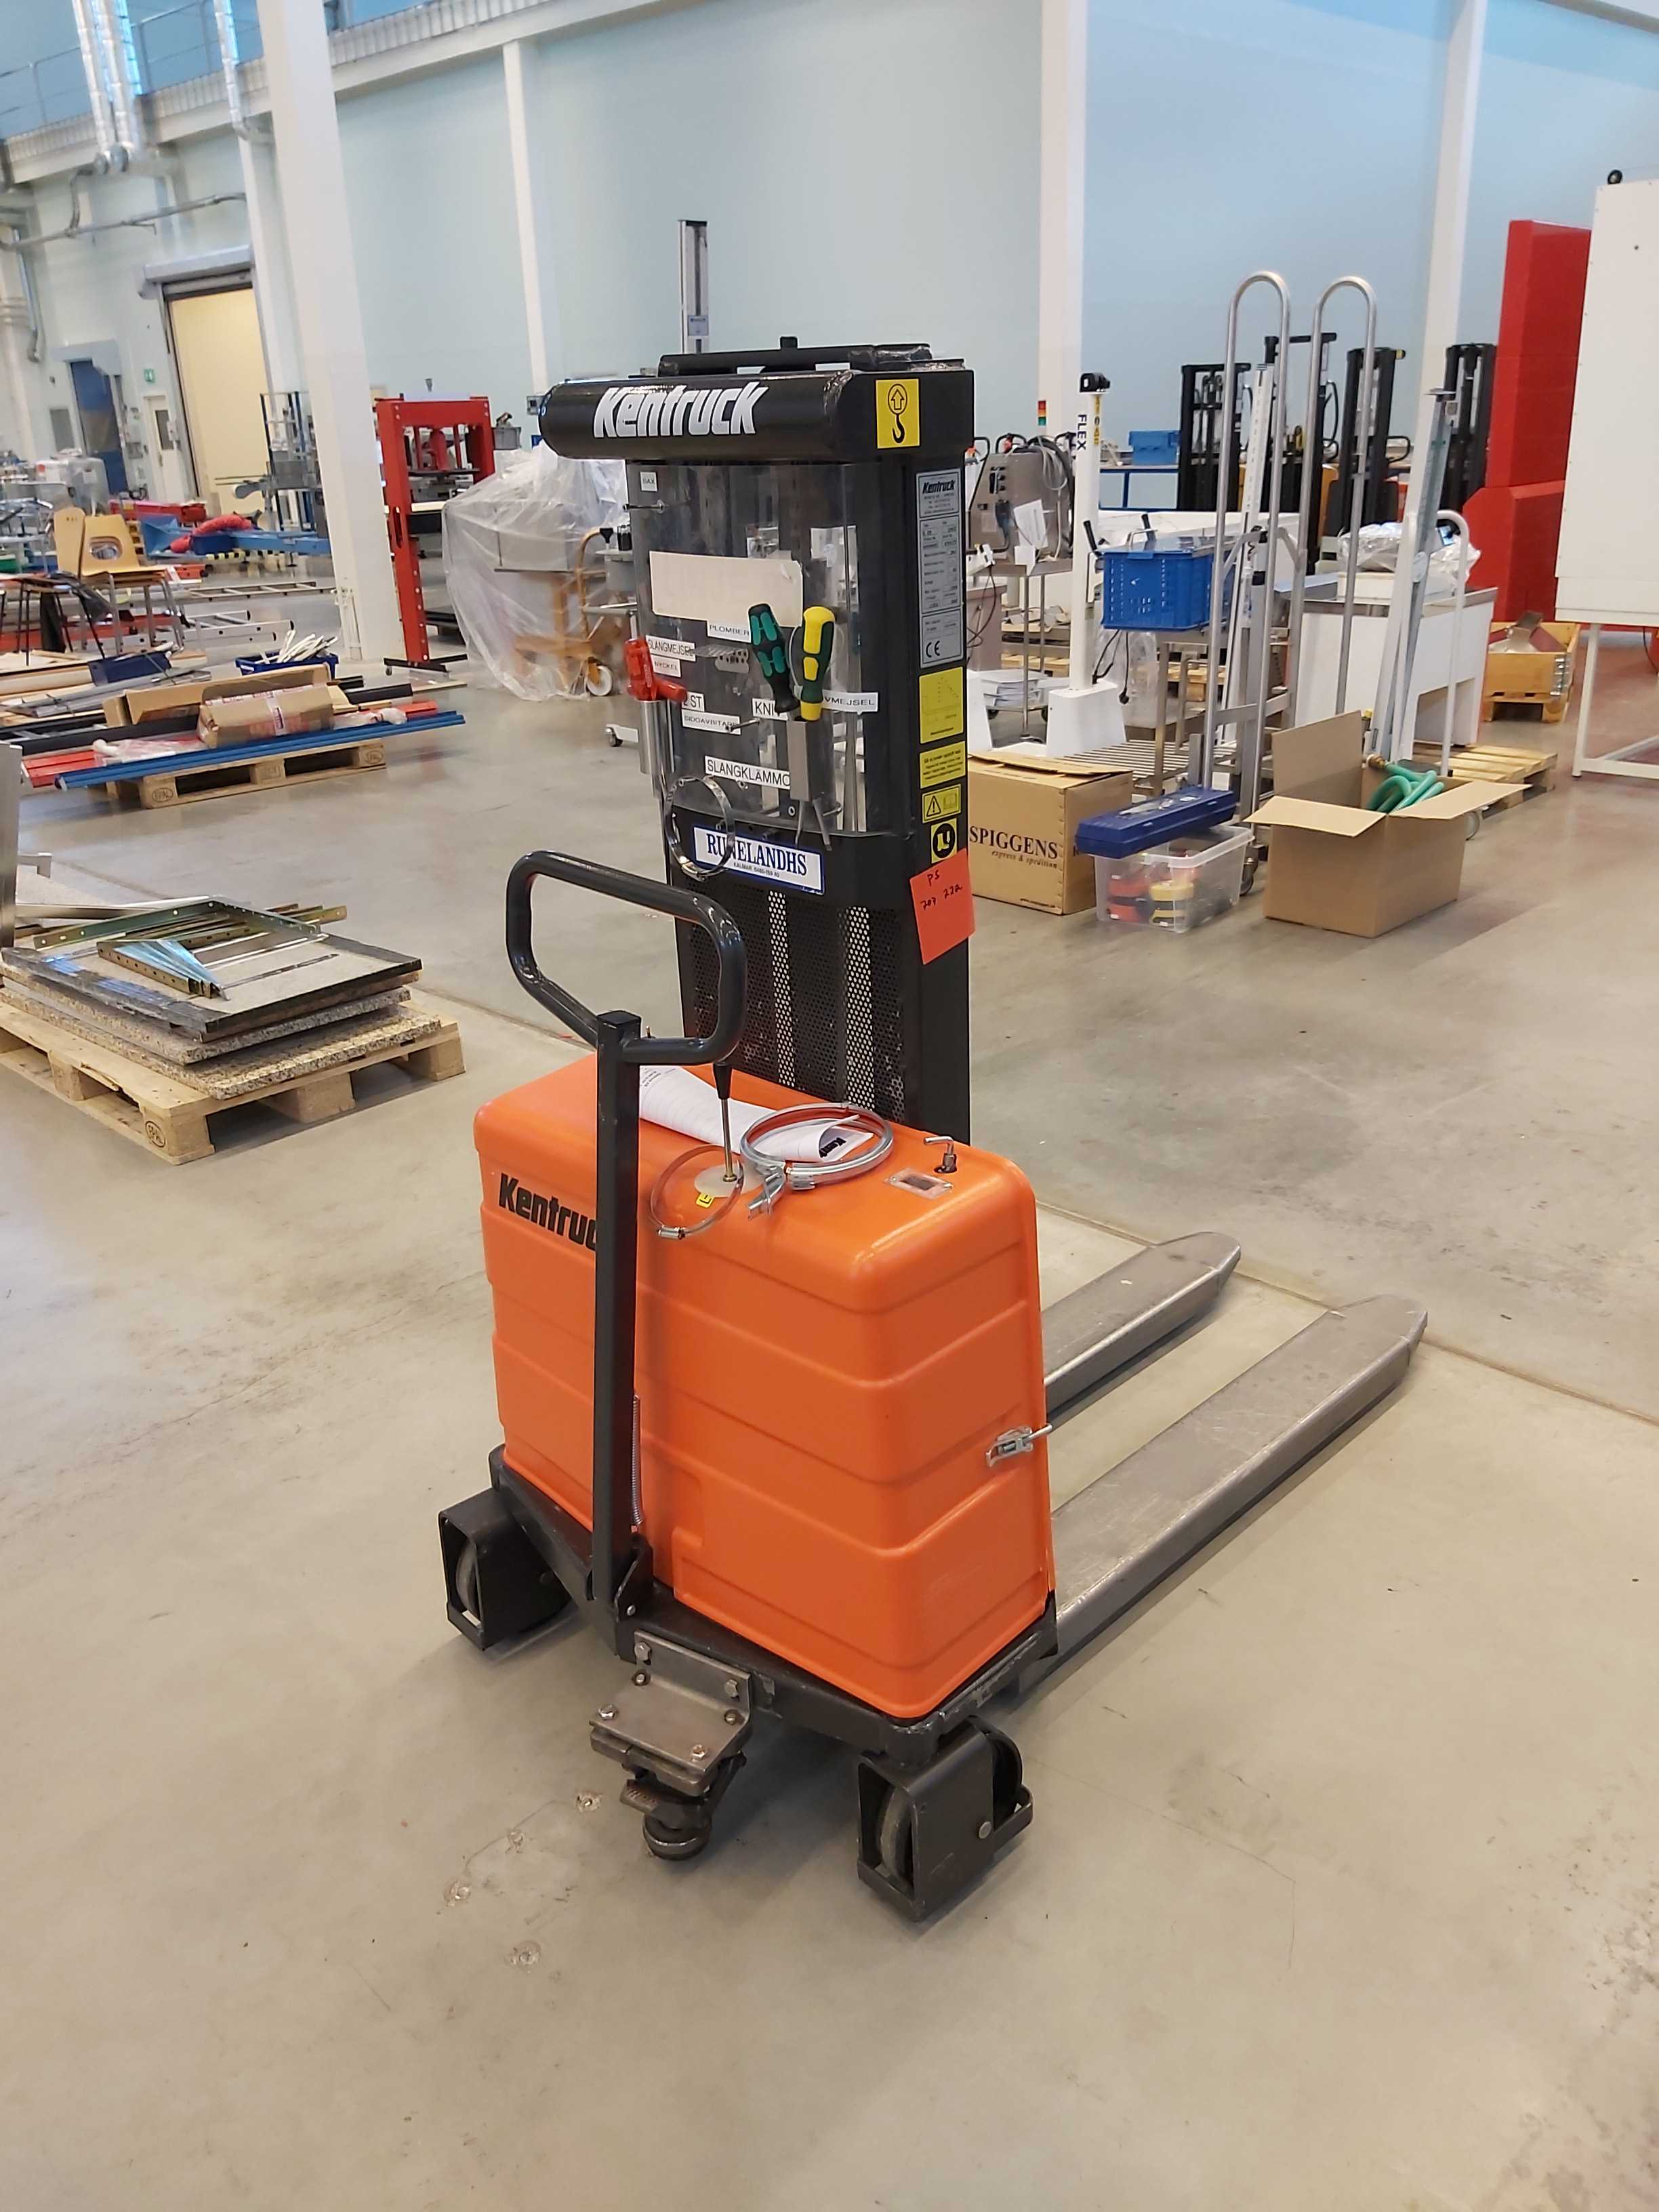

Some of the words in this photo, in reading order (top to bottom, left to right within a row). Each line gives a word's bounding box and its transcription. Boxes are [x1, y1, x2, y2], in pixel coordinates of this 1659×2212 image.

[594, 381, 769, 438] Kentruck
[1078, 414, 1087, 450] FLEX
[922, 480, 956, 494] Kentruck
[691, 695, 702, 709] ST
[755, 701, 780, 717] KNI
[824, 696, 875, 705] VMEJSEL
[708, 759, 791, 787] SLANGKLÄMMO
[969, 825, 1059, 860] SPIGGENS
[499, 1172, 597, 1252] Kentruc
